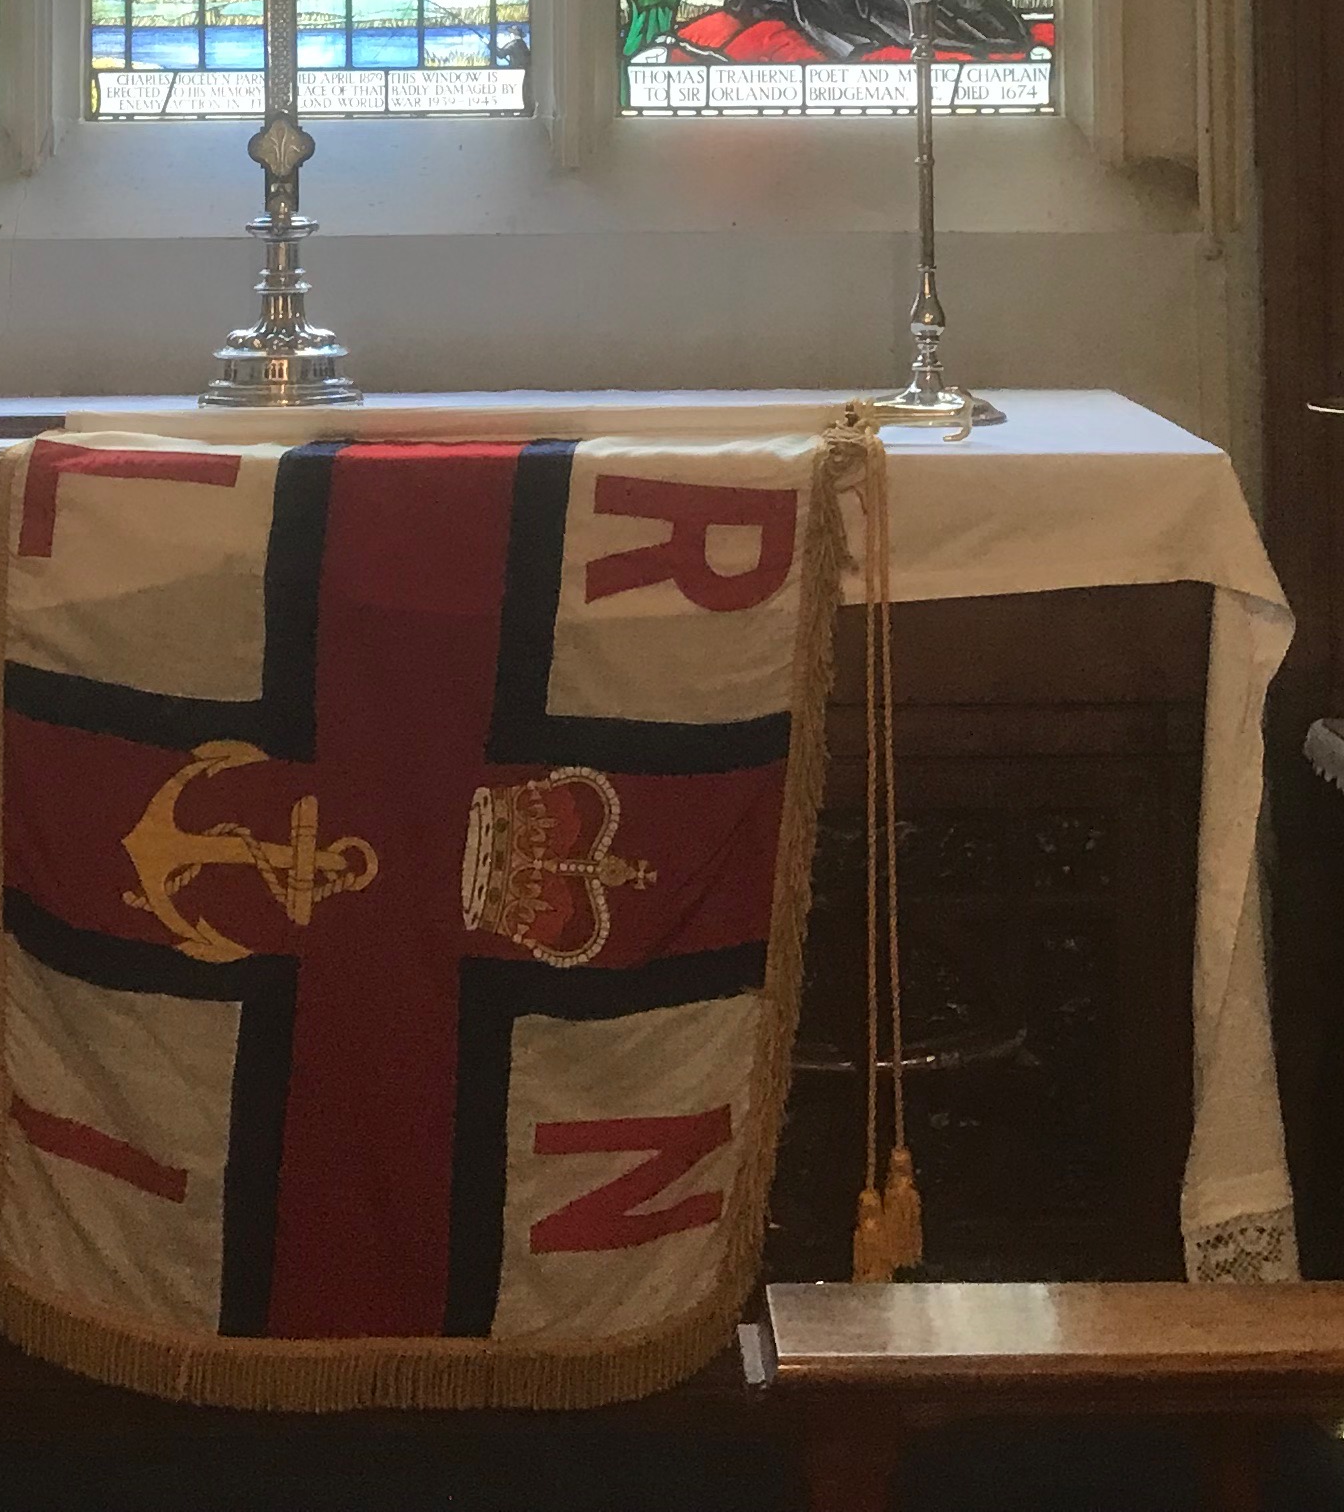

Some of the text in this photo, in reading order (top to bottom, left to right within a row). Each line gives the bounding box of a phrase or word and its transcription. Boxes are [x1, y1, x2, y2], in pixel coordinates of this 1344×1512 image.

[116, 73, 171, 86] CHARLES
[175, 73, 232, 87] JOCELYN
[297, 72, 316, 84] IED
[320, 72, 356, 85] APRIL
[358, 72, 383, 84] 1879
[390, 72, 416, 84] THIS
[423, 72, 483, 84] WINDOW
[487, 72, 499, 83] IS
[630, 69, 705, 85] THOMAS
[809, 68, 850, 84] POET
[858, 68, 889, 83] AND
[966, 67, 1048, 83] CHAPLAIN
[106, 86, 161, 99] ERECTED
[188, 86, 206, 98] HIS
[211, 86, 264, 98] MEMORY
[297, 85, 327, 97] LACE
[331, 85, 346, 96] OF
[352, 85, 385, 97] THAT
[390, 84, 430, 96] BADLY
[435, 84, 497, 96] DAMAGED
[501, 84, 518, 96] BY
[643, 87, 669, 102] TO
[678, 87, 700, 102] SIR
[711, 86, 798, 102] ORLANDO
[955, 86, 989, 100] DIED
[1001, 85, 1038, 100] 1674
[118, 99, 165, 111] ENEMY
[169, 99, 222, 110] ACTION
[227, 99, 240, 109] IN
[338, 97, 385, 109] WORLD
[391, 97, 421, 108] WAR
[584, 474, 798, 612] R
